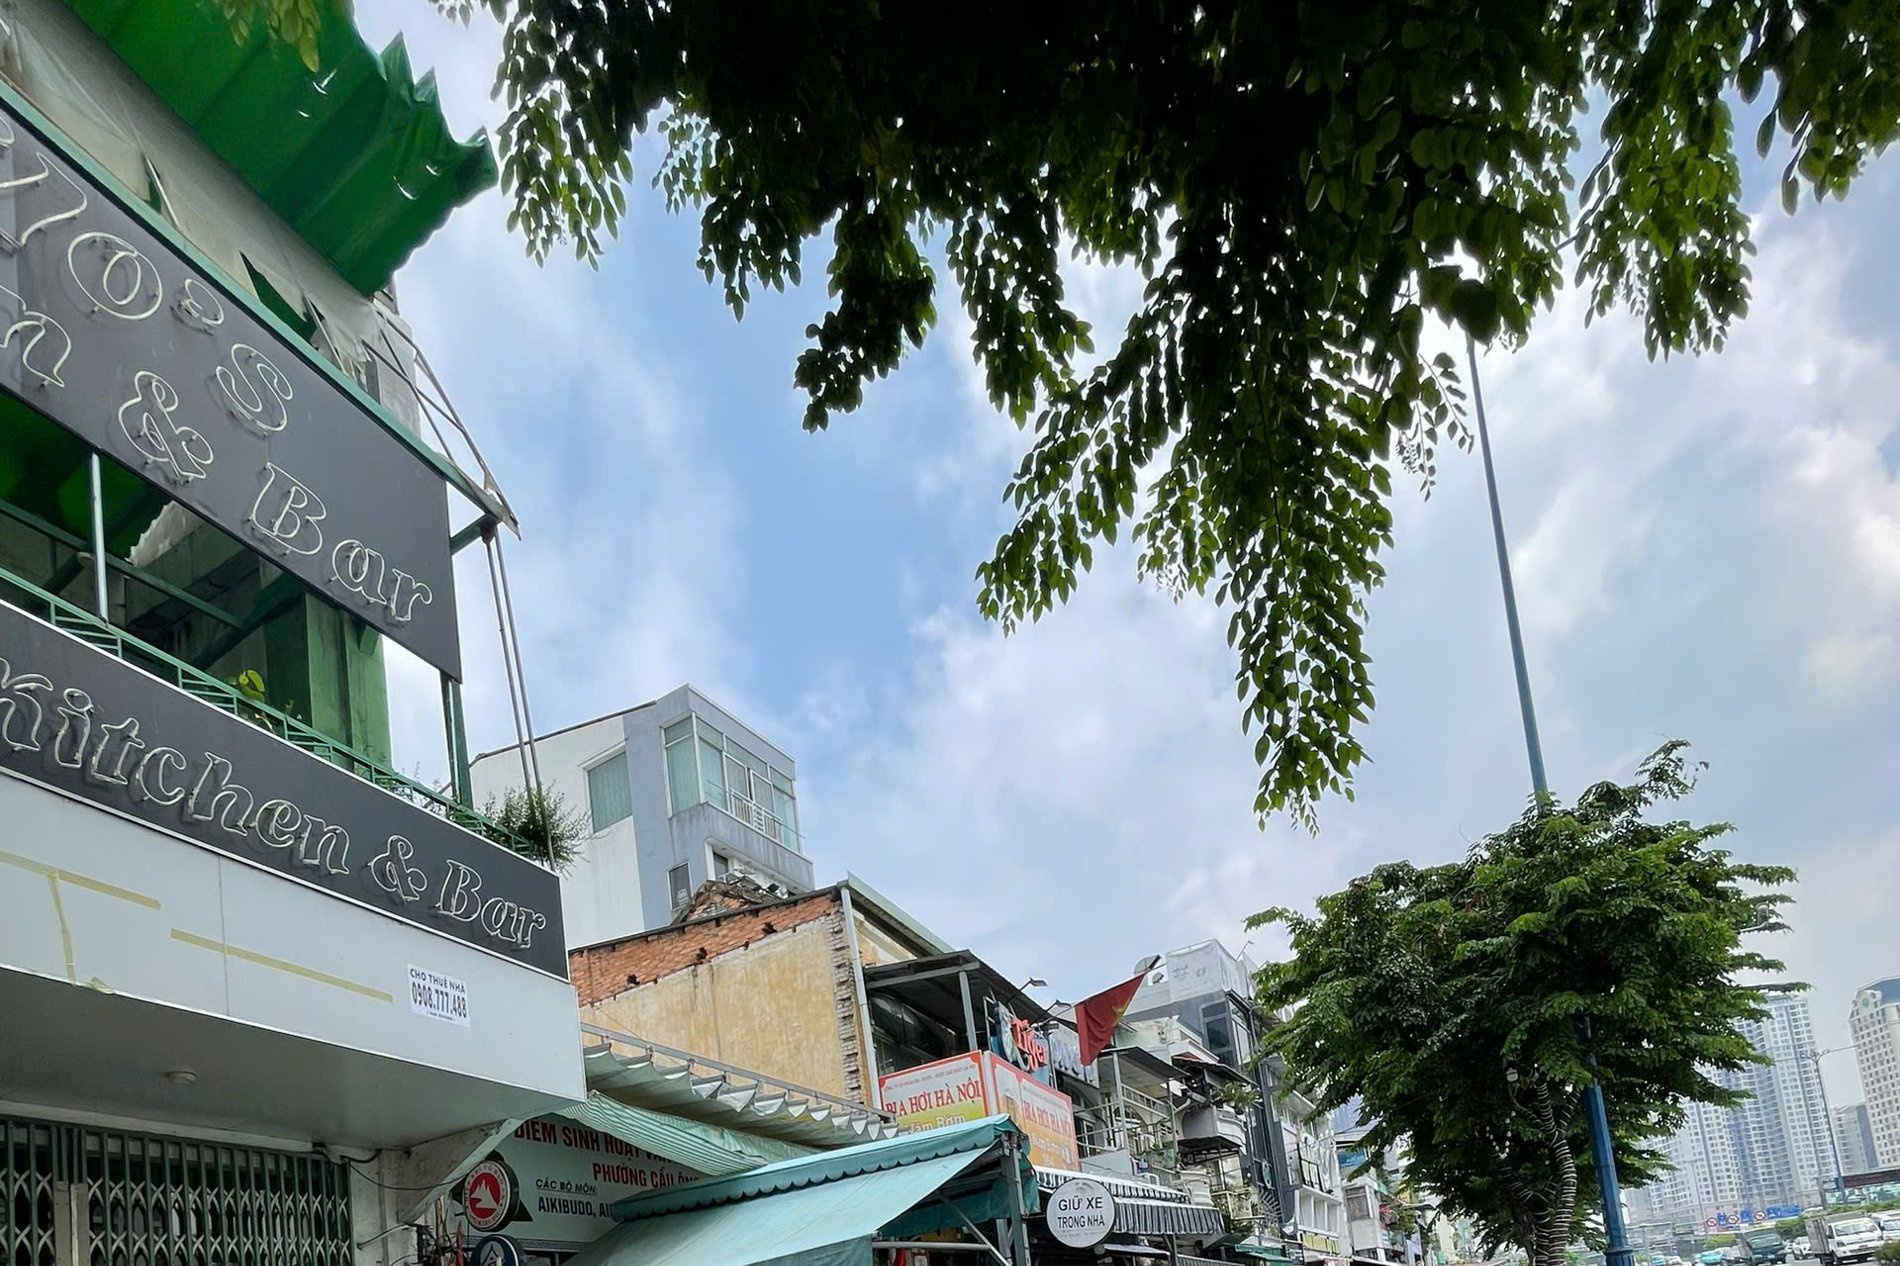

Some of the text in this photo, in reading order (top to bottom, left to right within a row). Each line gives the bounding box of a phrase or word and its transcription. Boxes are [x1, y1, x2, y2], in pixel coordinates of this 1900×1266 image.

[250, 461, 433, 622] Bar
[368, 834, 429, 903] &
[436, 859, 547, 949] Bar
[410, 968, 427, 981] CHO
[428, 975, 448, 989] THUÊ
[909, 1091, 933, 1114] HƠI
[934, 1083, 956, 1108] HÀ
[957, 1077, 982, 1104] NỘI
[562, 1126, 600, 1151] SINH
[1058, 1195, 1103, 1211] GIỮ XE
[1057, 1215, 1086, 1229] TRONG
